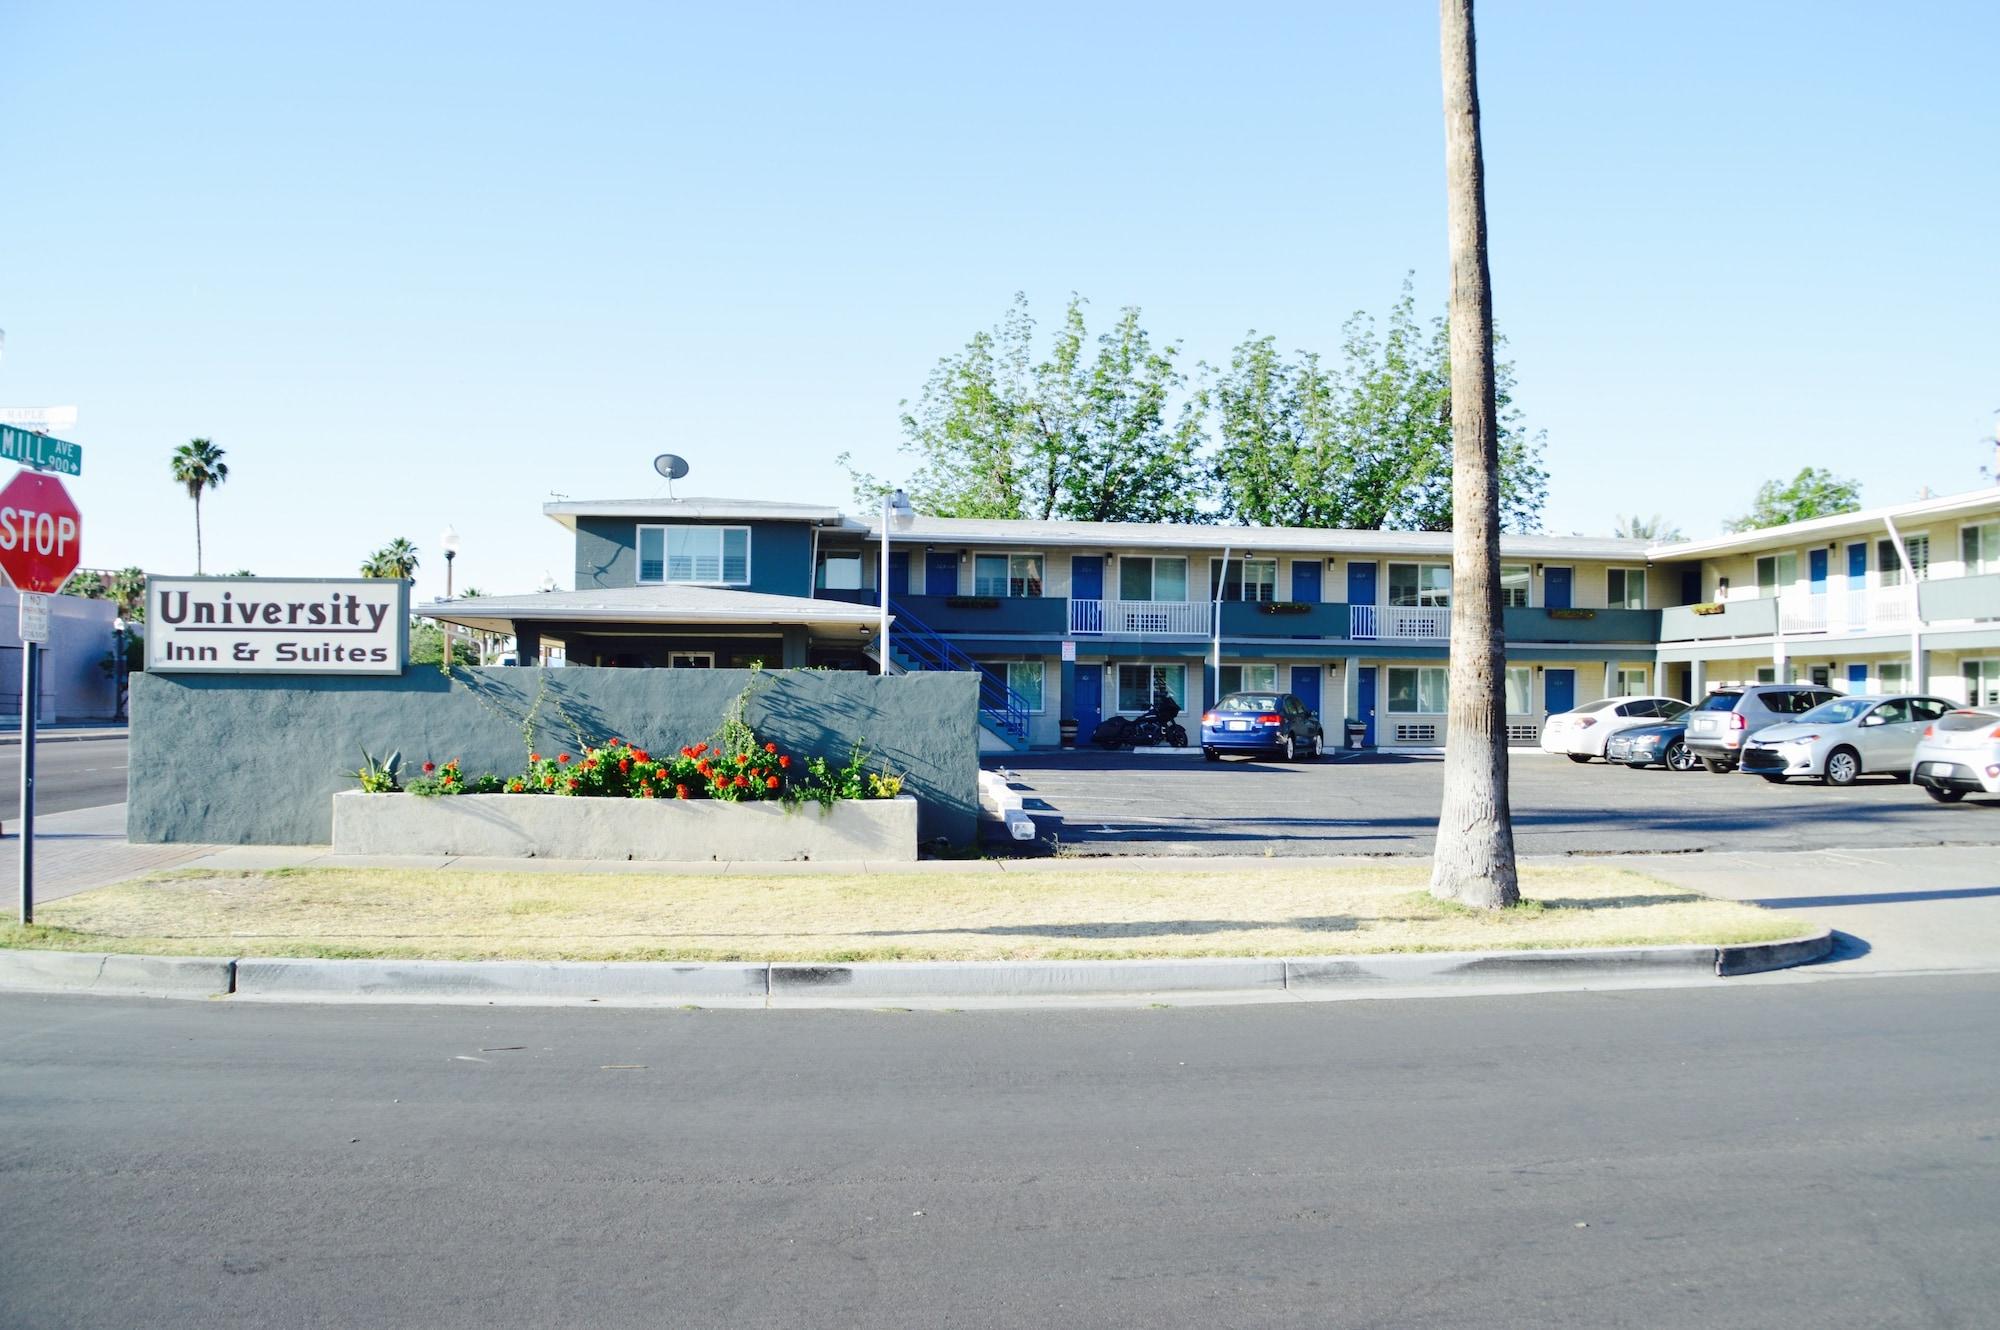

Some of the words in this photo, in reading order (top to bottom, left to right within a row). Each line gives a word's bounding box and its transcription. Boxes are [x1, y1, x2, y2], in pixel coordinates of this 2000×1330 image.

[2, 428, 45, 464] MILL
[55, 440, 74, 457] AVE
[48, 455, 69, 472] 900
[0, 506, 76, 557] STOP
[158, 591, 390, 633] University
[166, 641, 218, 662] Inn
[232, 642, 260, 662] &
[276, 642, 388, 663] Suites
